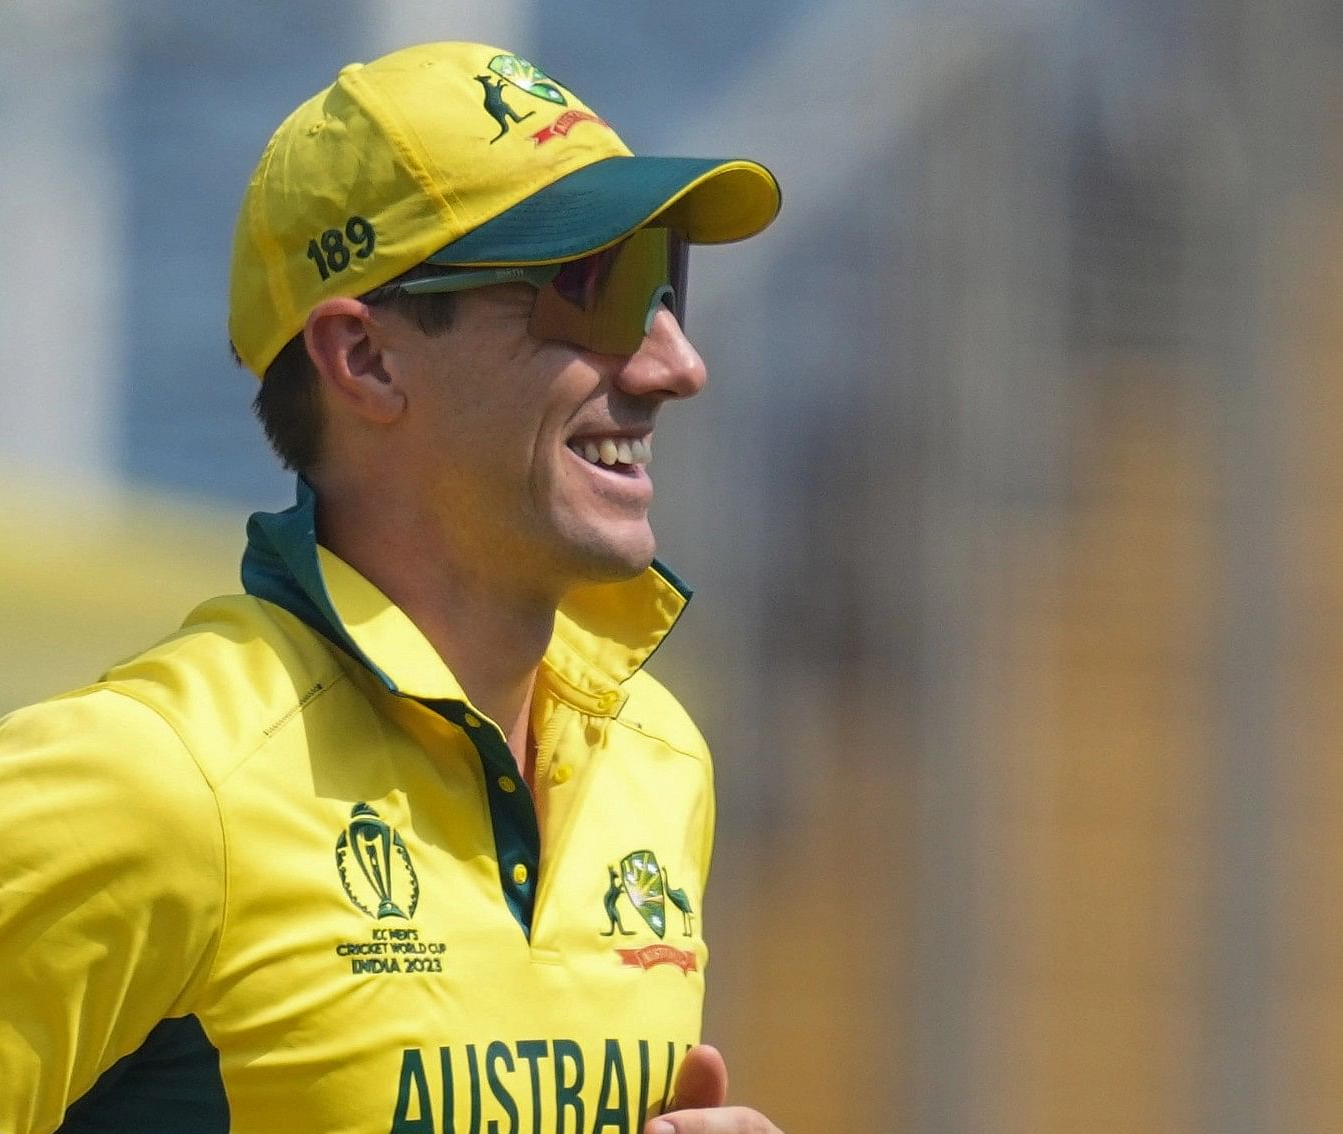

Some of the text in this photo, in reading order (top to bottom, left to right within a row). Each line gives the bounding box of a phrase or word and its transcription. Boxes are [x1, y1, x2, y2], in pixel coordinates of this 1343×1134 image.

[307, 215, 375, 282] 189
[336, 943, 447, 956] CRICKET WORLD CUP
[352, 958, 443, 974] INDIA 2023
